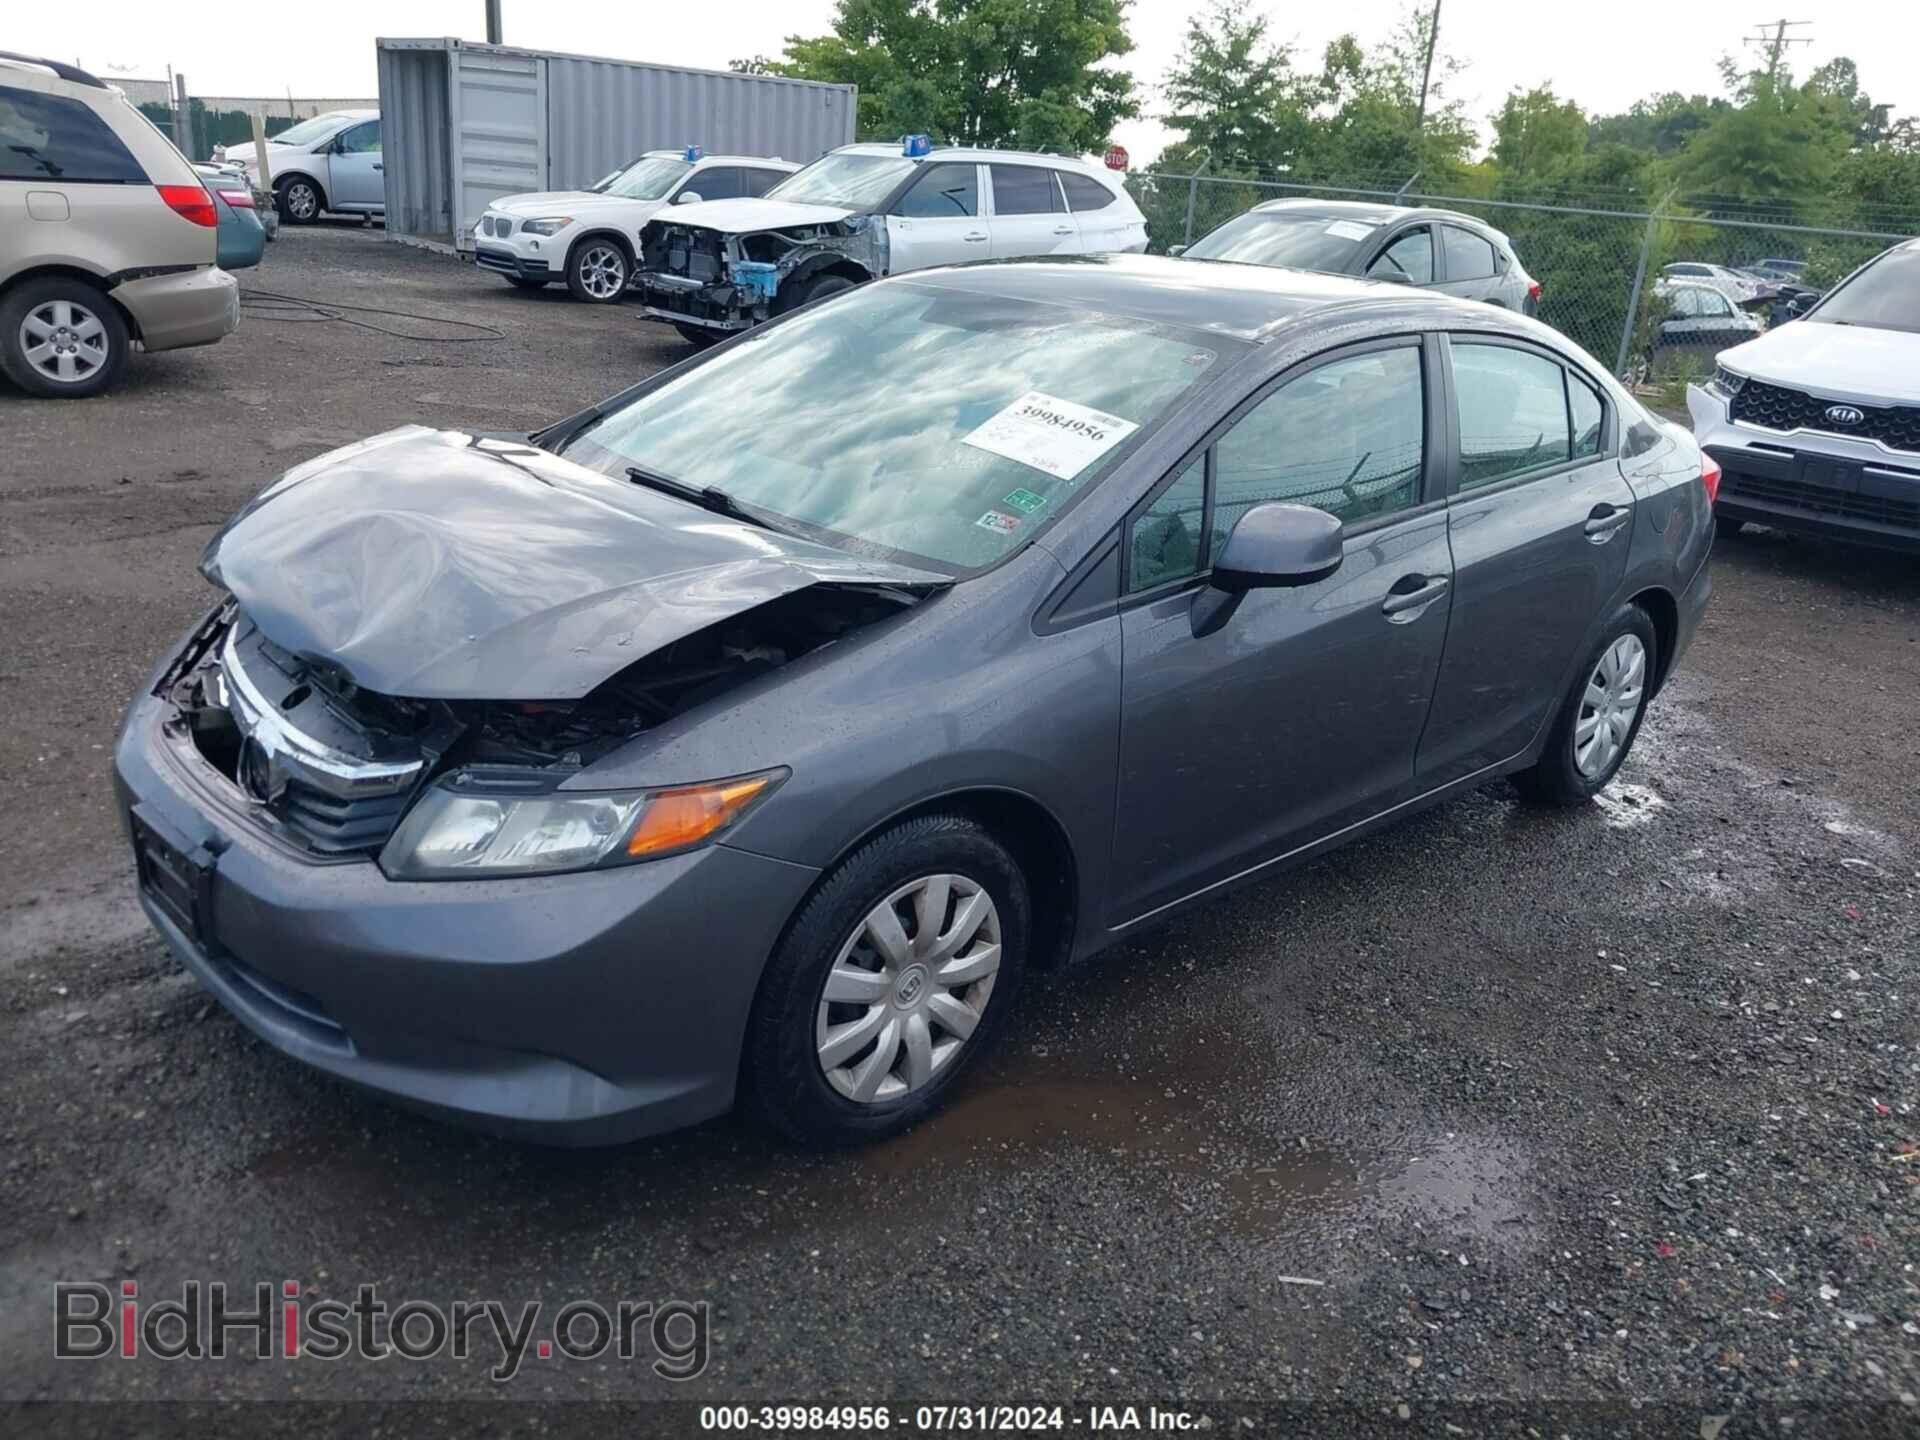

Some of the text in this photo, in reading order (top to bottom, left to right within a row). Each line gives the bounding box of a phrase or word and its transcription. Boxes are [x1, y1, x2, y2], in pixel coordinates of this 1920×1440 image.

[1105, 153, 1128, 165] STOP
[1831, 409, 1856, 422] KIA
[1015, 405, 1106, 441] 39984956
